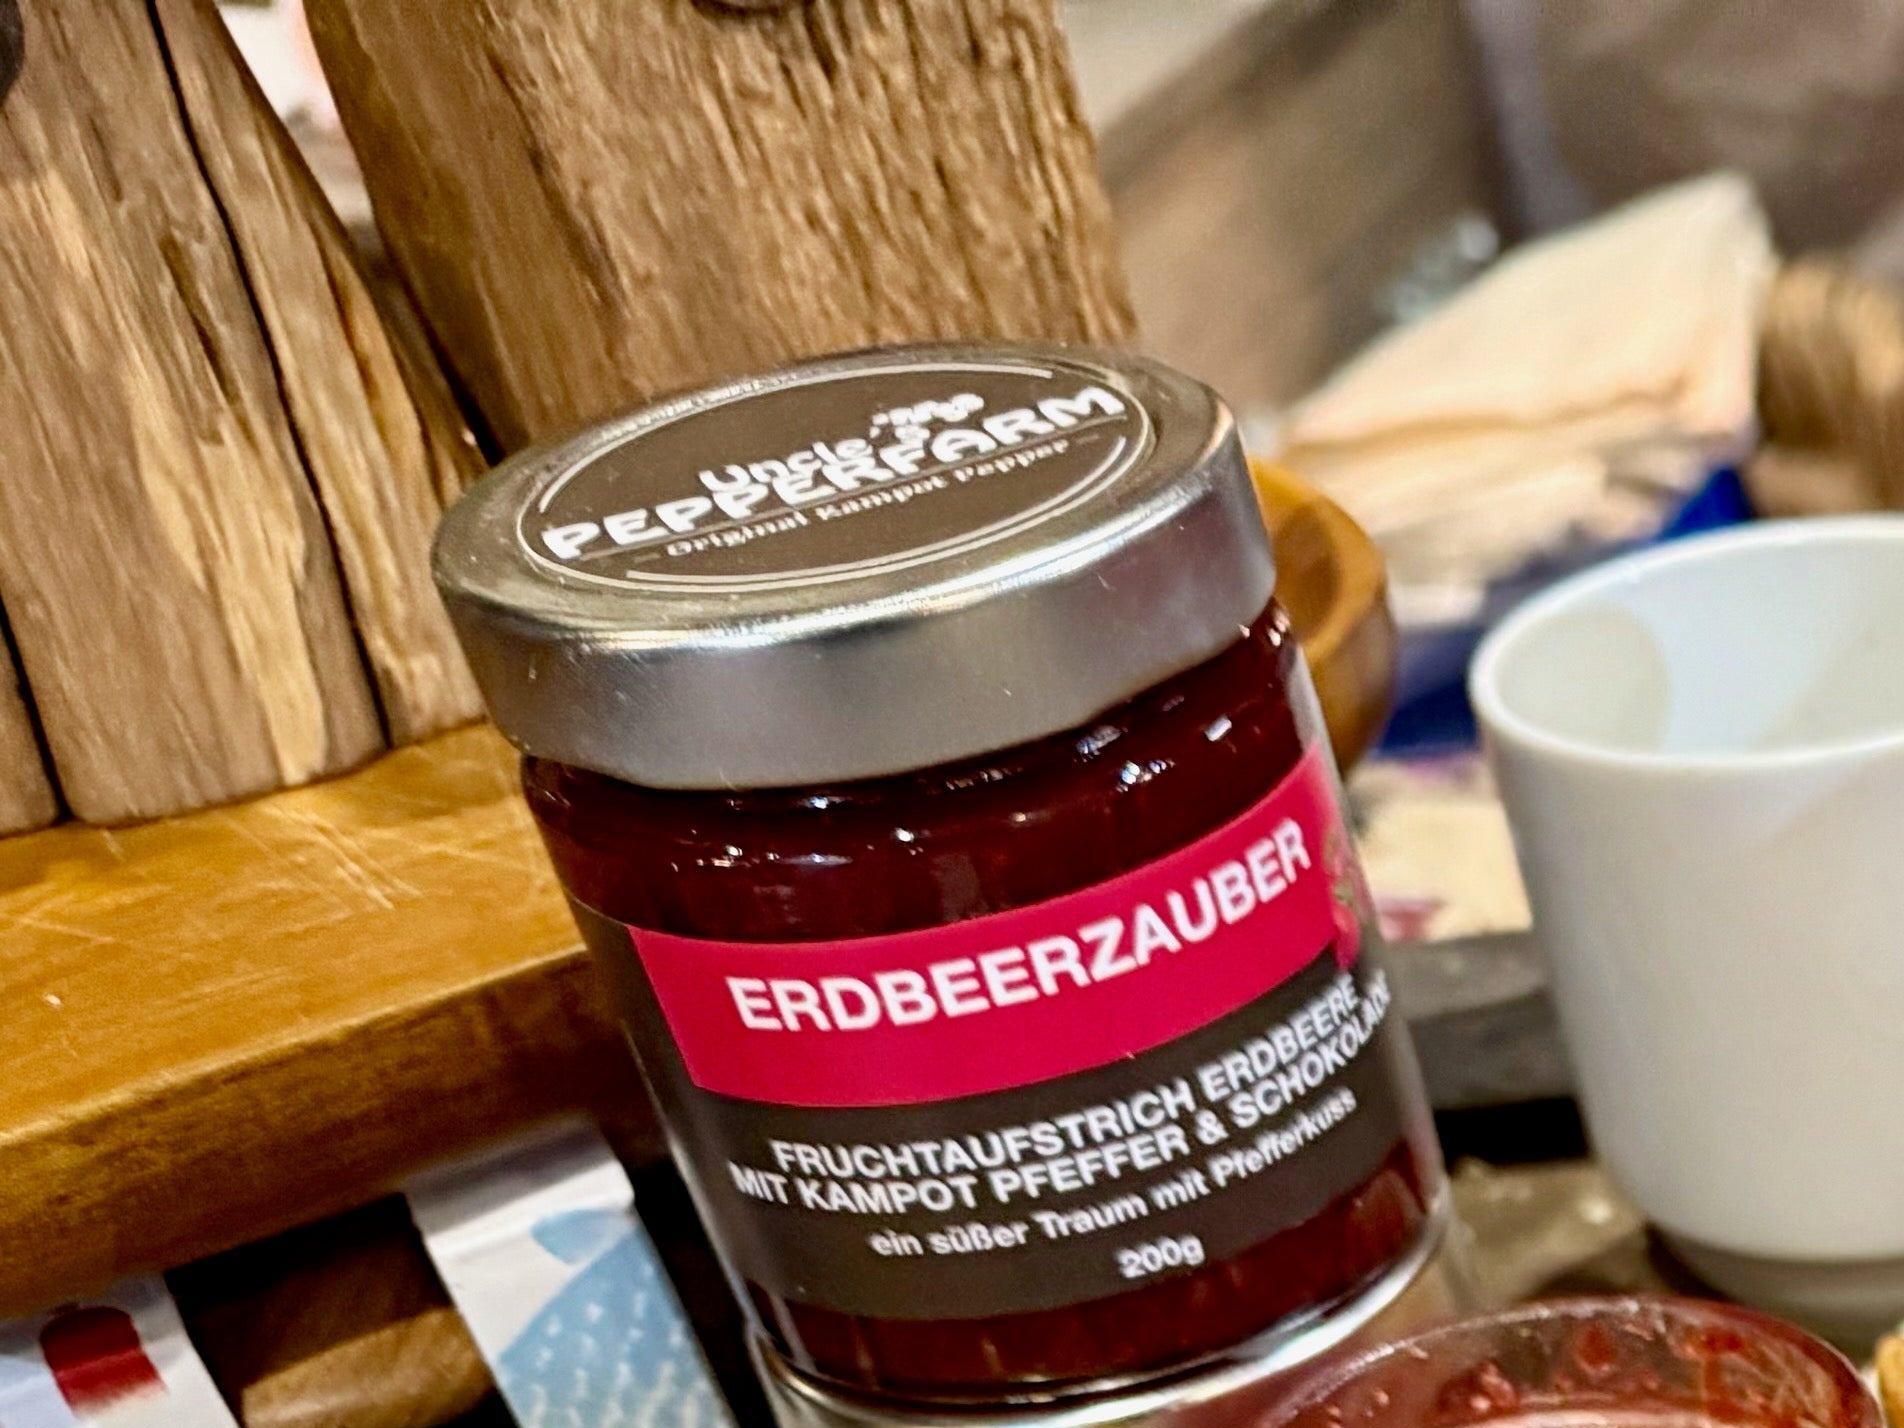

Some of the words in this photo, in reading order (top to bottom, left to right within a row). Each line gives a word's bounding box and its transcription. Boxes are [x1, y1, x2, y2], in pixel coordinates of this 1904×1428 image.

[539, 386, 1125, 561] PEPPERFARM
[725, 817, 1311, 1033] ERDBEERZAUBER
[728, 1160, 790, 1206] MIT
[797, 1174, 979, 1215] KAMPOT
[991, 1125, 1188, 1205] PFEFFER
[1195, 1109, 1229, 1145] &
[768, 1077, 1195, 1179] FRUCHTAUFSTRICH
[1198, 972, 1360, 1103] ERDBEERE
[868, 1230, 924, 1257] ein
[929, 1220, 1030, 1256] süßer
[1033, 1190, 1149, 1243] Traum
[1150, 1170, 1209, 1214] mit
[1208, 1085, 1357, 1190] Pfefferkuss
[1117, 1231, 1204, 1280] 200g
